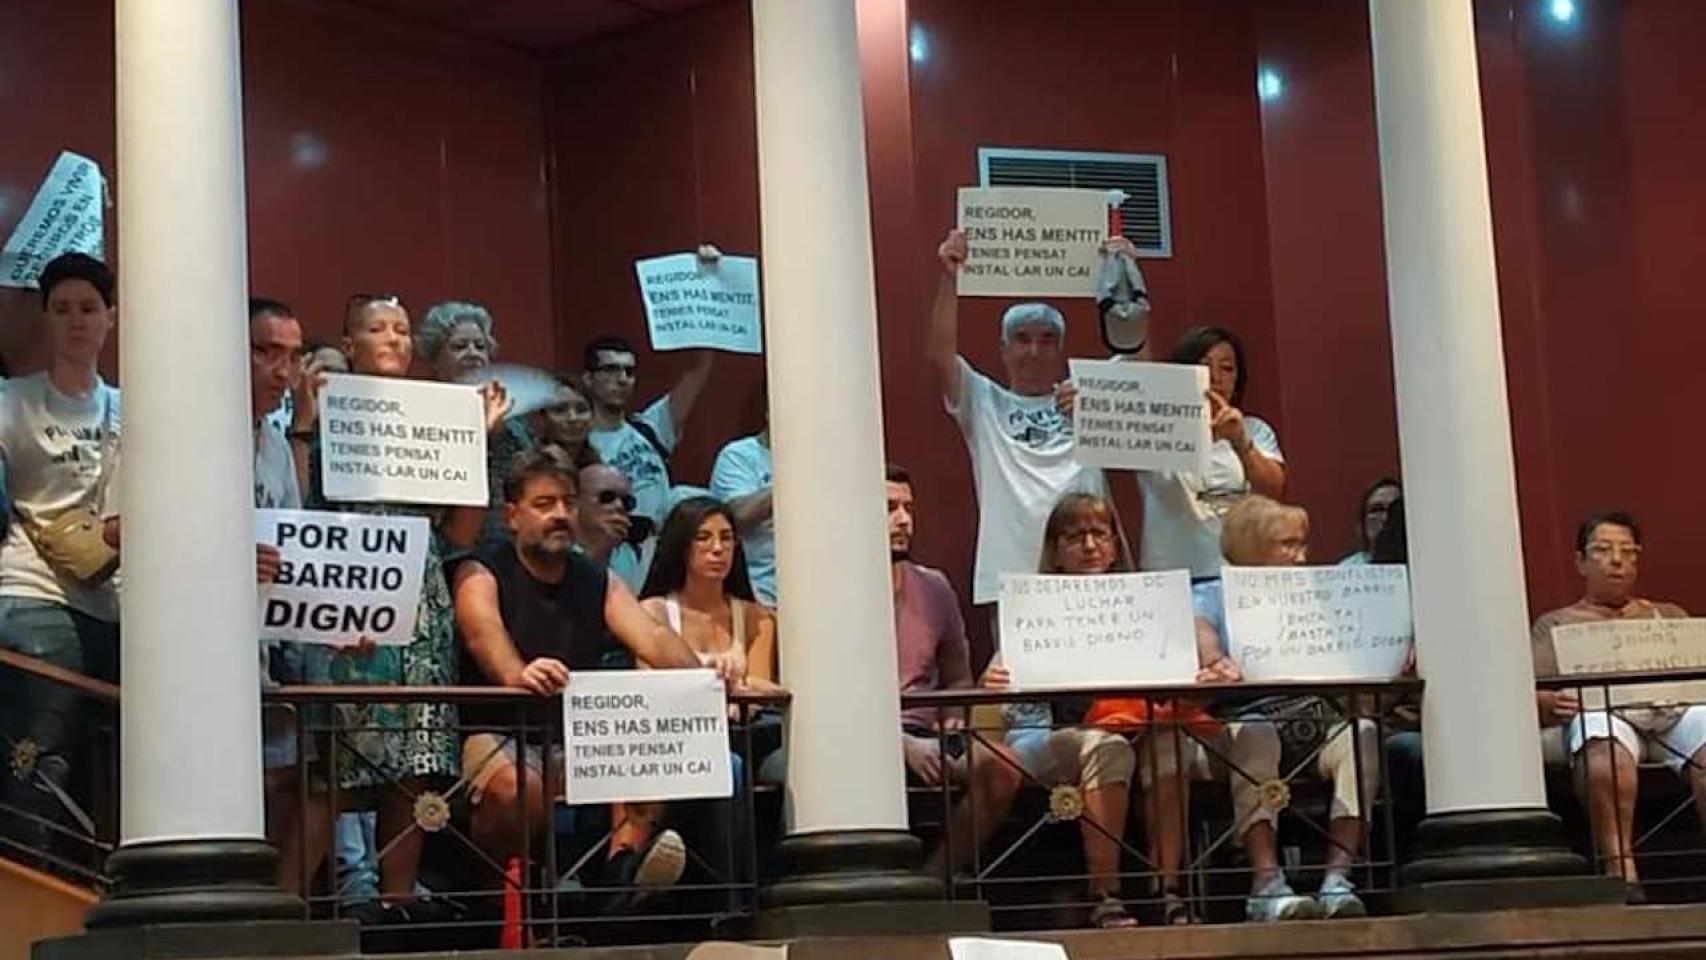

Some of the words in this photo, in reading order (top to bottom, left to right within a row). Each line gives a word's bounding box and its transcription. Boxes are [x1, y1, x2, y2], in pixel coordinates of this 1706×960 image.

[965, 206, 1036, 221] REGIDOR,
[965, 227, 998, 241] ENS
[1002, 228, 1037, 241] HAS
[1014, 248, 1067, 260] PENSAT
[1045, 265, 1064, 278] UN
[1067, 266, 1091, 278] CAI
[648, 290, 680, 305] ENS
[682, 287, 708, 299] HAS
[326, 395, 405, 416] REGIDOR,
[1080, 397, 1111, 413] ENS
[1114, 399, 1147, 415] HAS
[328, 420, 365, 436] ENS
[369, 423, 408, 440] HAS
[1080, 418, 1124, 433] TENIES
[1127, 420, 1174, 435] PENSAT
[330, 441, 382, 458] TENIES
[384, 445, 442, 462] PENSAT
[1154, 438, 1173, 451] UN
[1175, 440, 1196, 453] CAI
[418, 466, 440, 481] UN
[442, 467, 469, 482] CAI
[276, 522, 349, 550] POR
[361, 528, 408, 554] UN
[273, 561, 404, 591] BARRIO
[1064, 594, 1136, 611] LUCHAR
[264, 599, 398, 633] DIGNO
[571, 694, 649, 710] REGIDOR,
[572, 719, 609, 737] ENS
[613, 719, 651, 736] HAS
[574, 744, 626, 758] TENIES
[628, 741, 684, 757] PENSAT
[662, 763, 684, 776] UN
[686, 761, 712, 774] CAI
